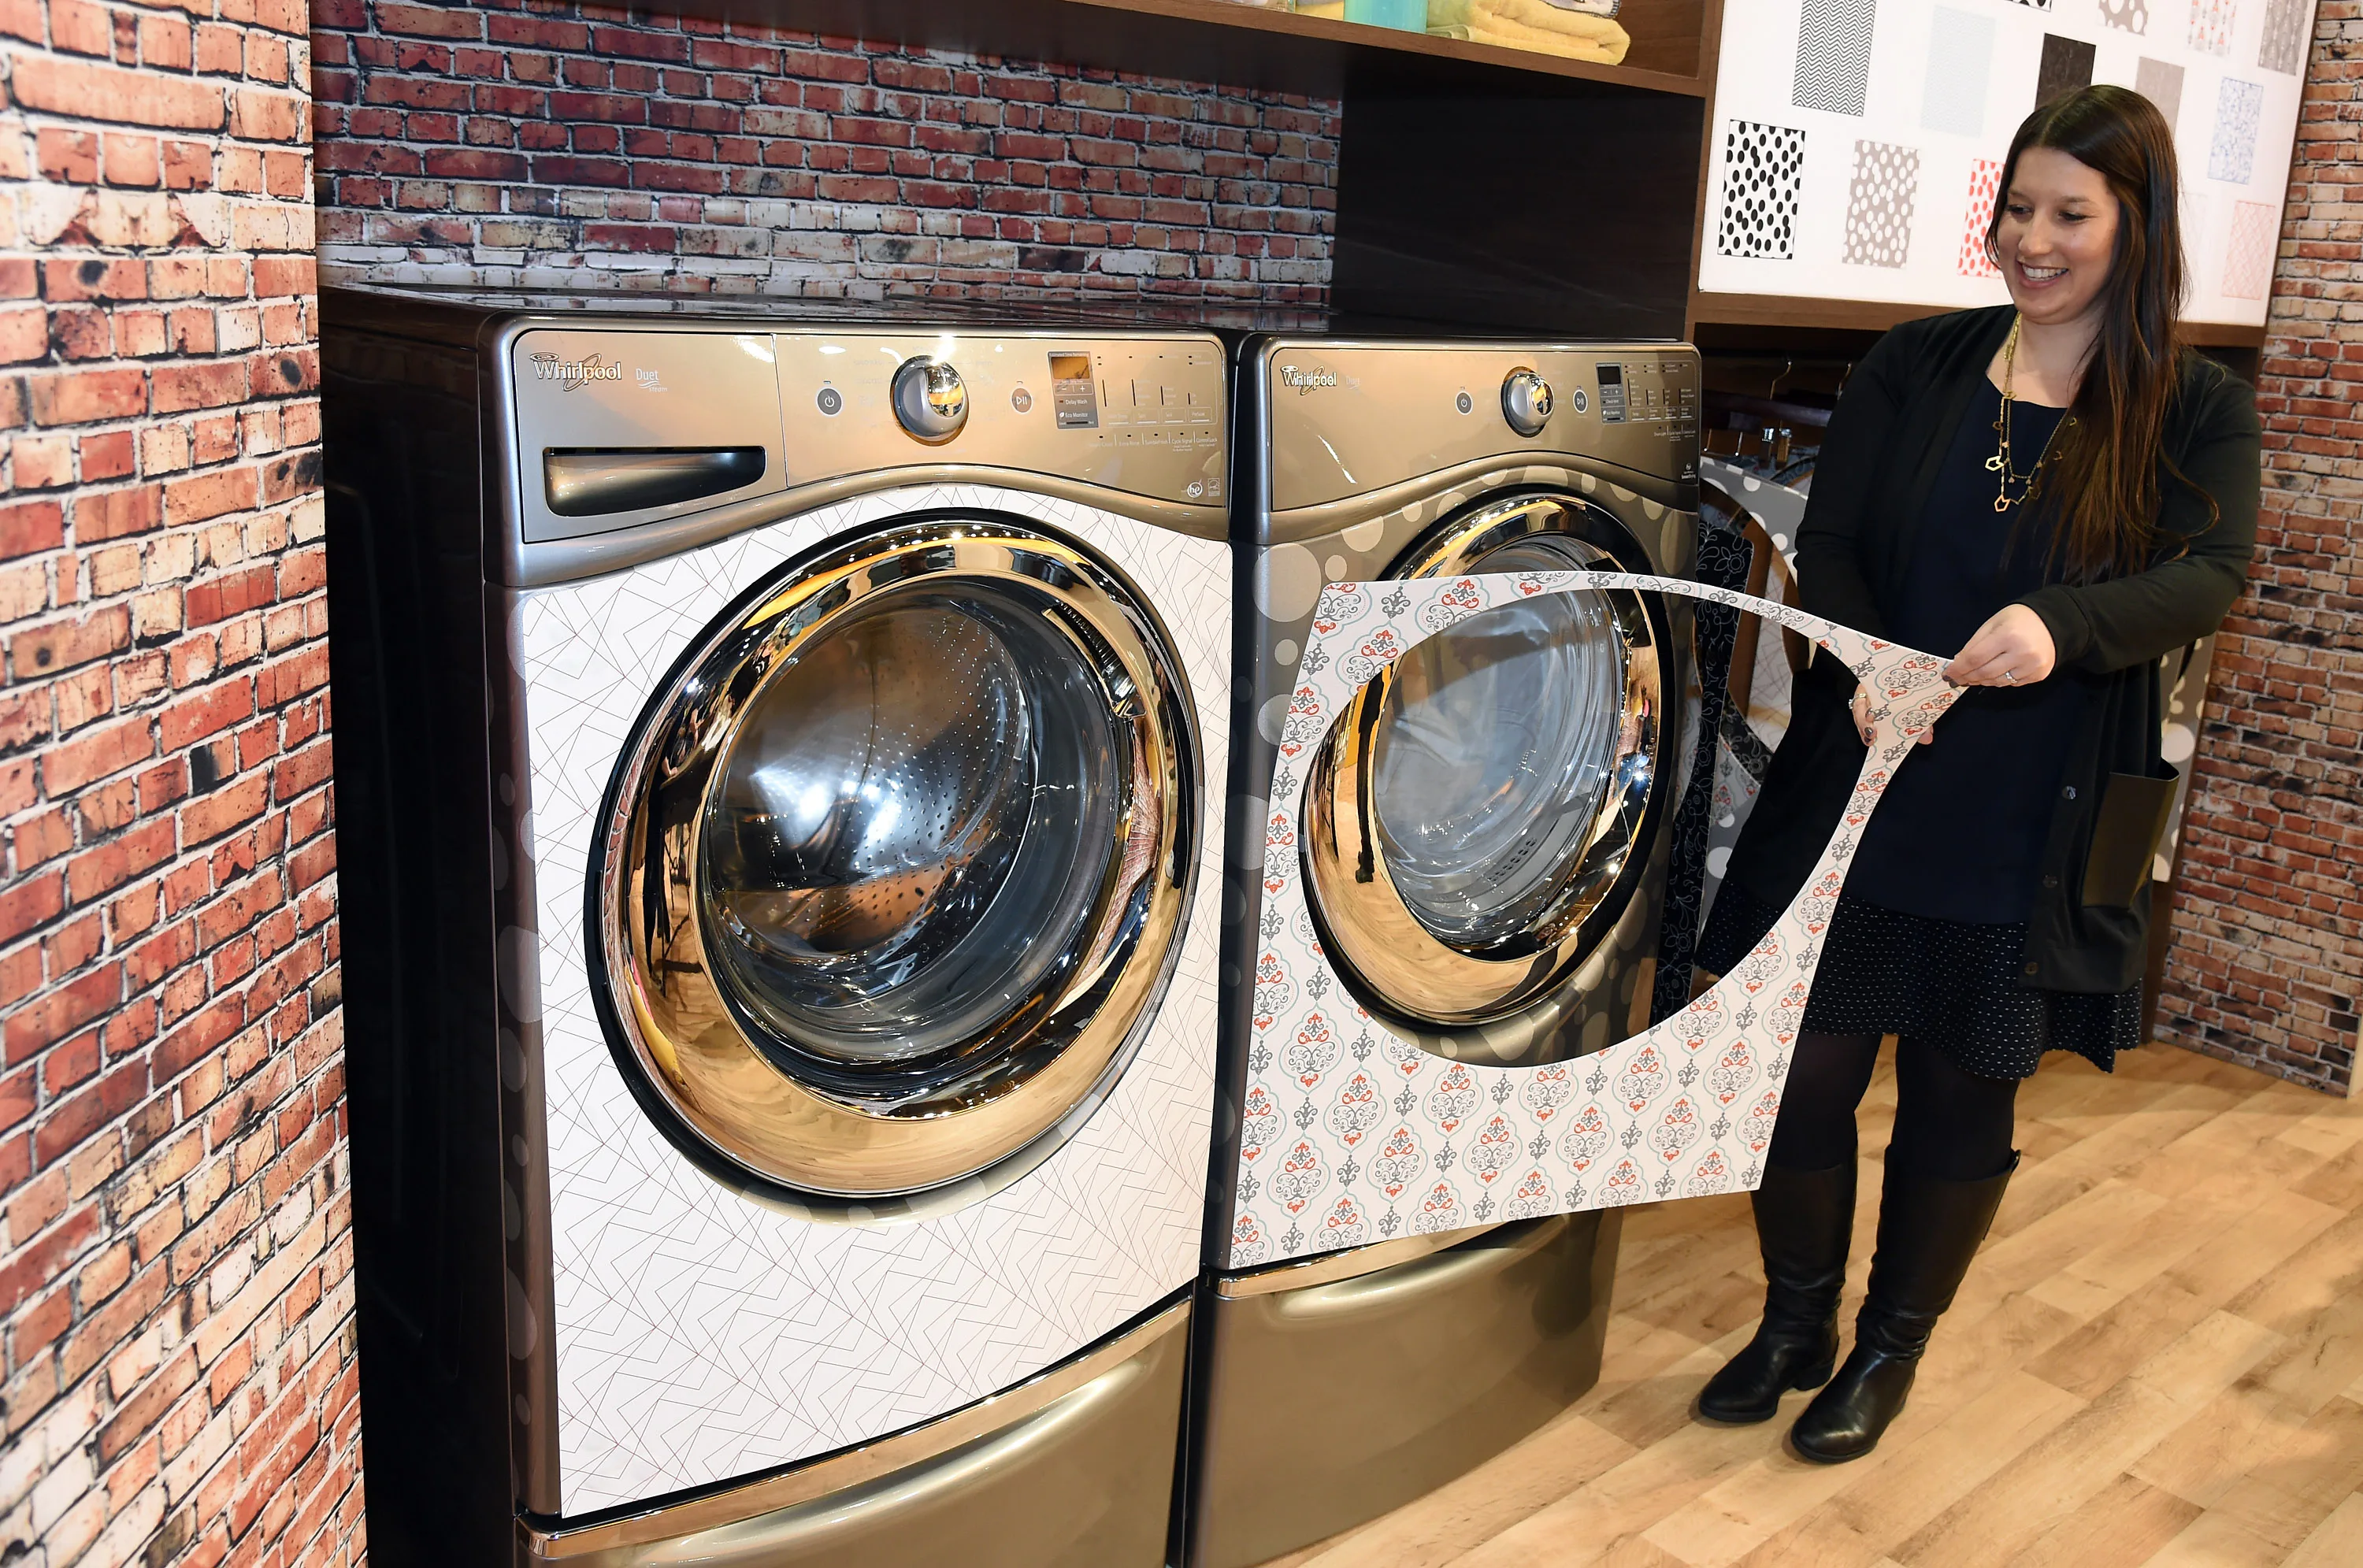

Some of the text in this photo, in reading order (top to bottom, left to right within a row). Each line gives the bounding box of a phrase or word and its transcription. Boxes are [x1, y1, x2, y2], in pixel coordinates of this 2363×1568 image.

[532, 360, 622, 386] Whirlpool
[636, 367, 659, 380] Duet
[1282, 371, 1338, 391] Whirlpool
